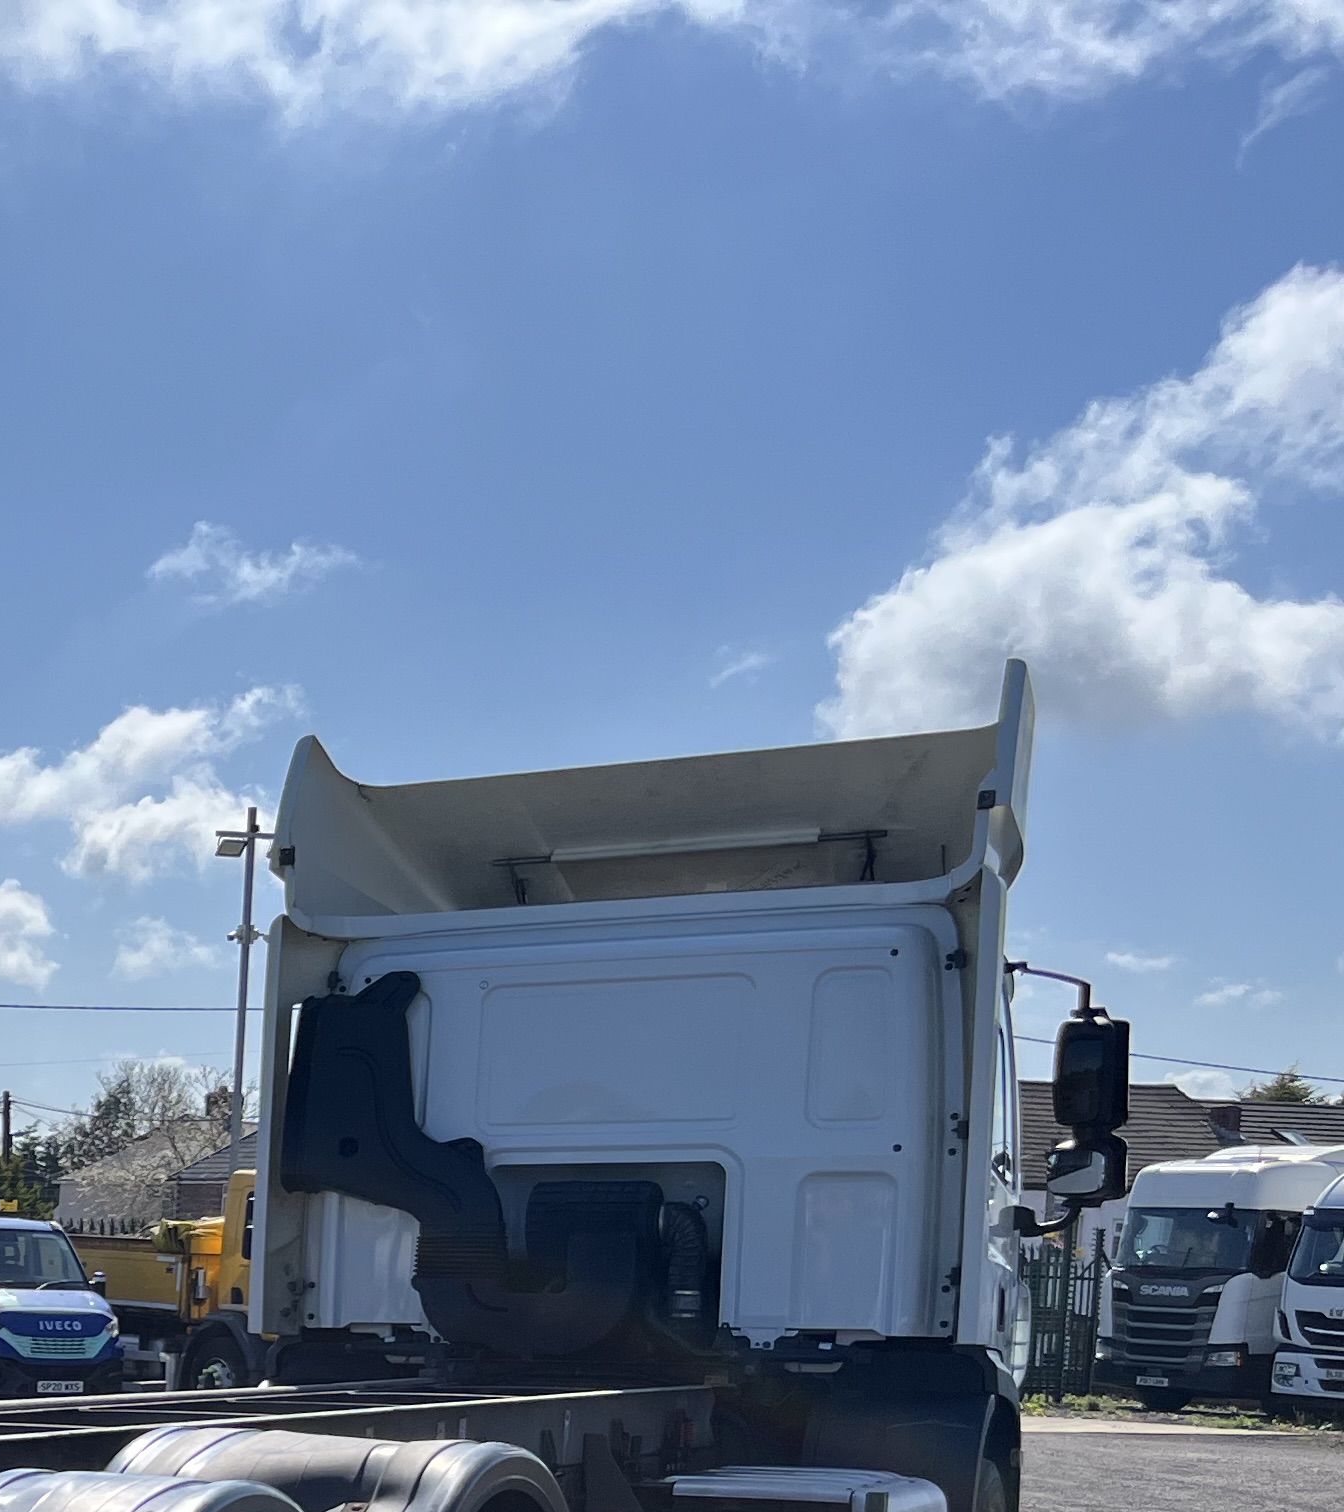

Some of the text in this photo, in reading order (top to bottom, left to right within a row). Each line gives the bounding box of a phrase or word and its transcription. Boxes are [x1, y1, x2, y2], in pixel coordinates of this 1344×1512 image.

[1139, 1284, 1190, 1297] SCANIA
[38, 1320, 82, 1331] IVECO
[39, 1382, 63, 1391] SP20
